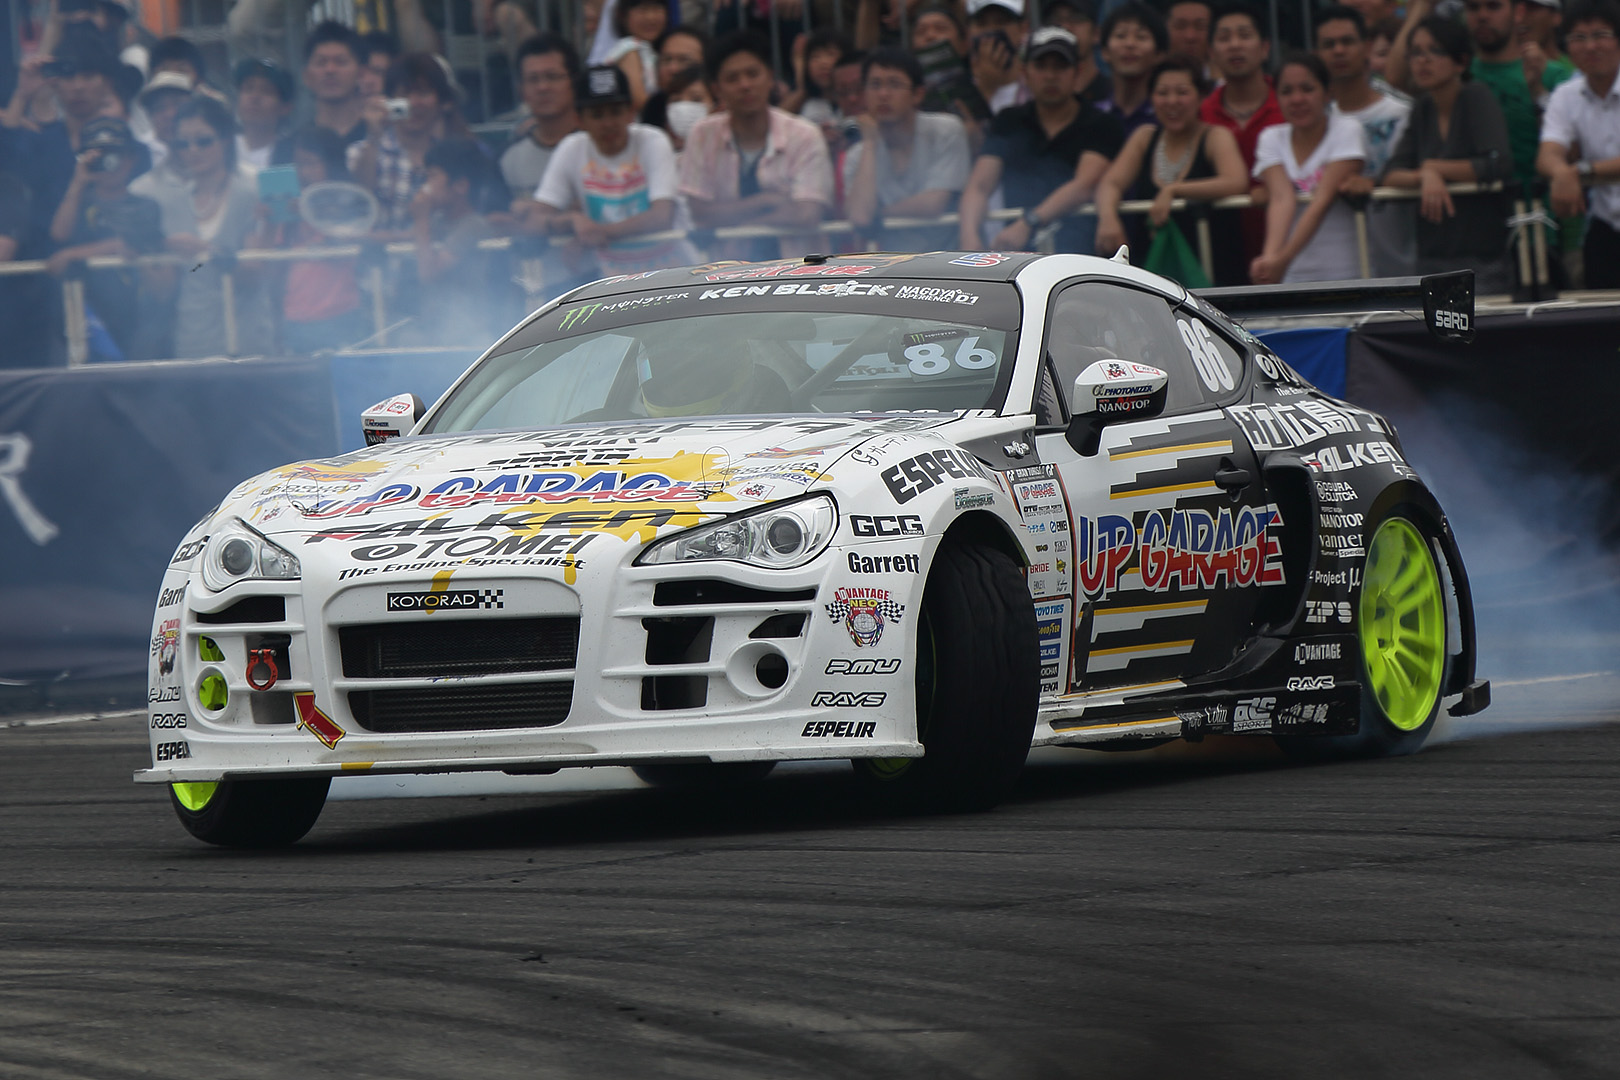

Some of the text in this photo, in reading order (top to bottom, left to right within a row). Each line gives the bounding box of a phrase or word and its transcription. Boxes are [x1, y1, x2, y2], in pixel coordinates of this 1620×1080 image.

[699, 282, 890, 300] KEN BLOCK
[894, 293, 952, 303] EXPERIENCE
[899, 286, 956, 299] NAGOYA
[600, 292, 690, 311] MONSTER
[904, 336, 997, 376] 86
[1177, 317, 1234, 392] 86
[1104, 385, 1153, 396] PHOTONIZER
[1098, 399, 1150, 412] NANOTOP
[1300, 441, 1404, 474] FALKEN
[300, 471, 727, 521] UP GARAGE
[1019, 483, 1057, 500] UP GARAGE
[303, 509, 676, 544] FALKEN
[850, 515, 925, 536] GCG
[1320, 513, 1364, 528] NANOTOP
[1079, 503, 1286, 597] UP GARAGE
[337, 556, 587, 582] The Engine Specialist
[848, 552, 920, 574] Garrett
[1030, 563, 1050, 574] BRIDE
[1315, 570, 1346, 586] Project
[389, 593, 477, 609] KOYORAD
[834, 586, 890, 604] ADVANTAGE
[850, 599, 878, 608] NEO
[1294, 643, 1342, 664] ADVANTAGE
[1286, 675, 1336, 691] RAYS
[811, 692, 887, 707] RAYS
[151, 713, 187, 729] RAYS
[801, 721, 877, 738] ESPELIR
[1236, 720, 1268, 731] SPORT
